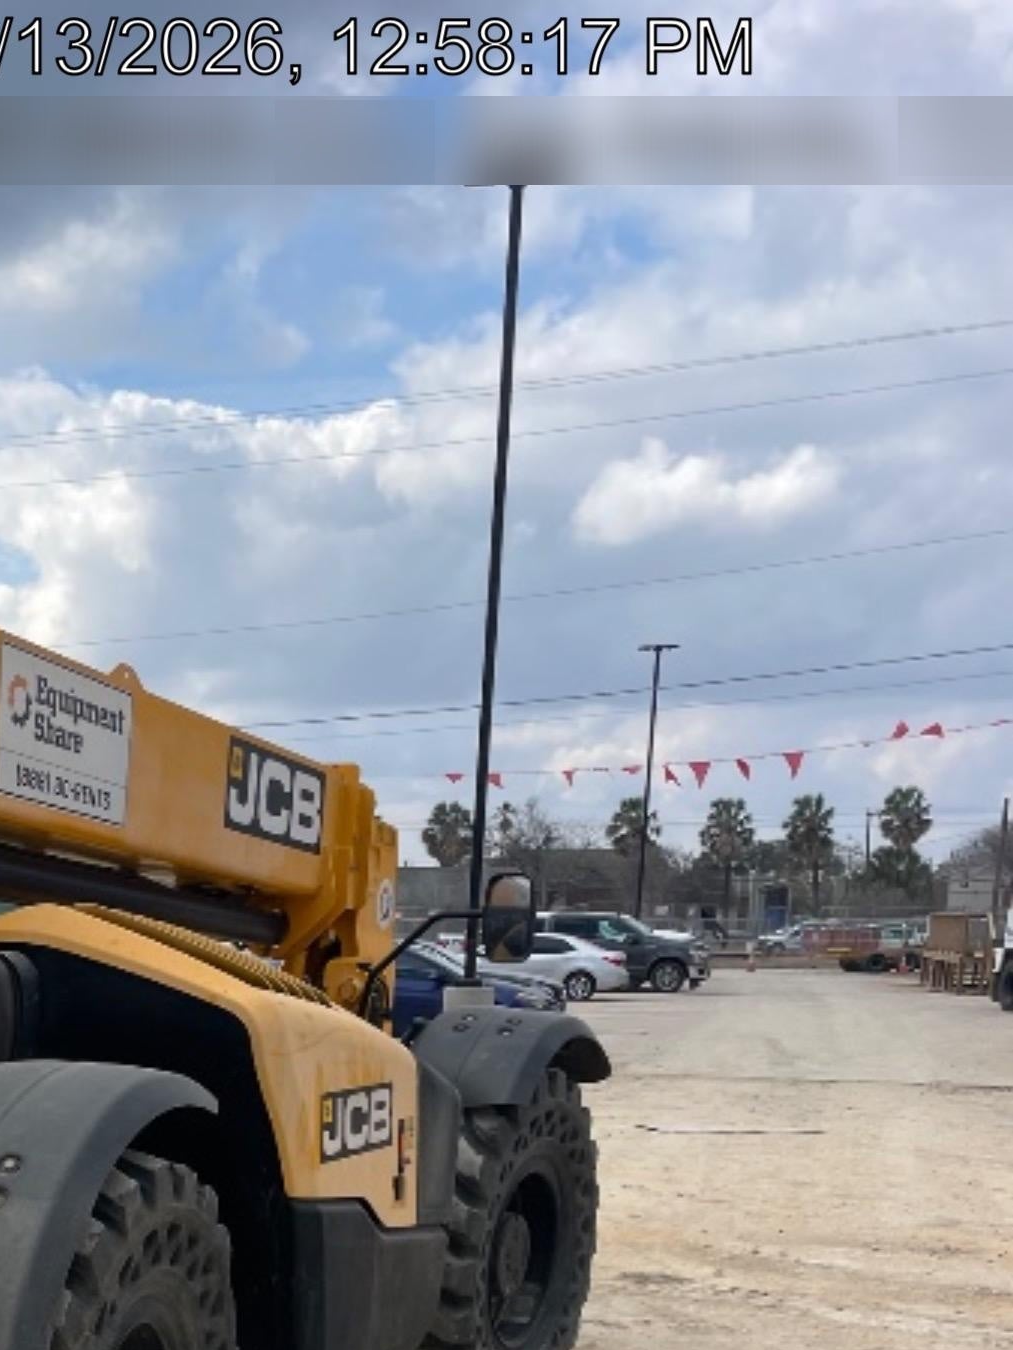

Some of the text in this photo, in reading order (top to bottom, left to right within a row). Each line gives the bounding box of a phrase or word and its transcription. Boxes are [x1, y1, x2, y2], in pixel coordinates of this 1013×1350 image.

[34, 712, 84, 754] Share
[35, 674, 125, 735] Equipment
[229, 751, 322, 844] JCB
[322, 1087, 391, 1156] JCB
